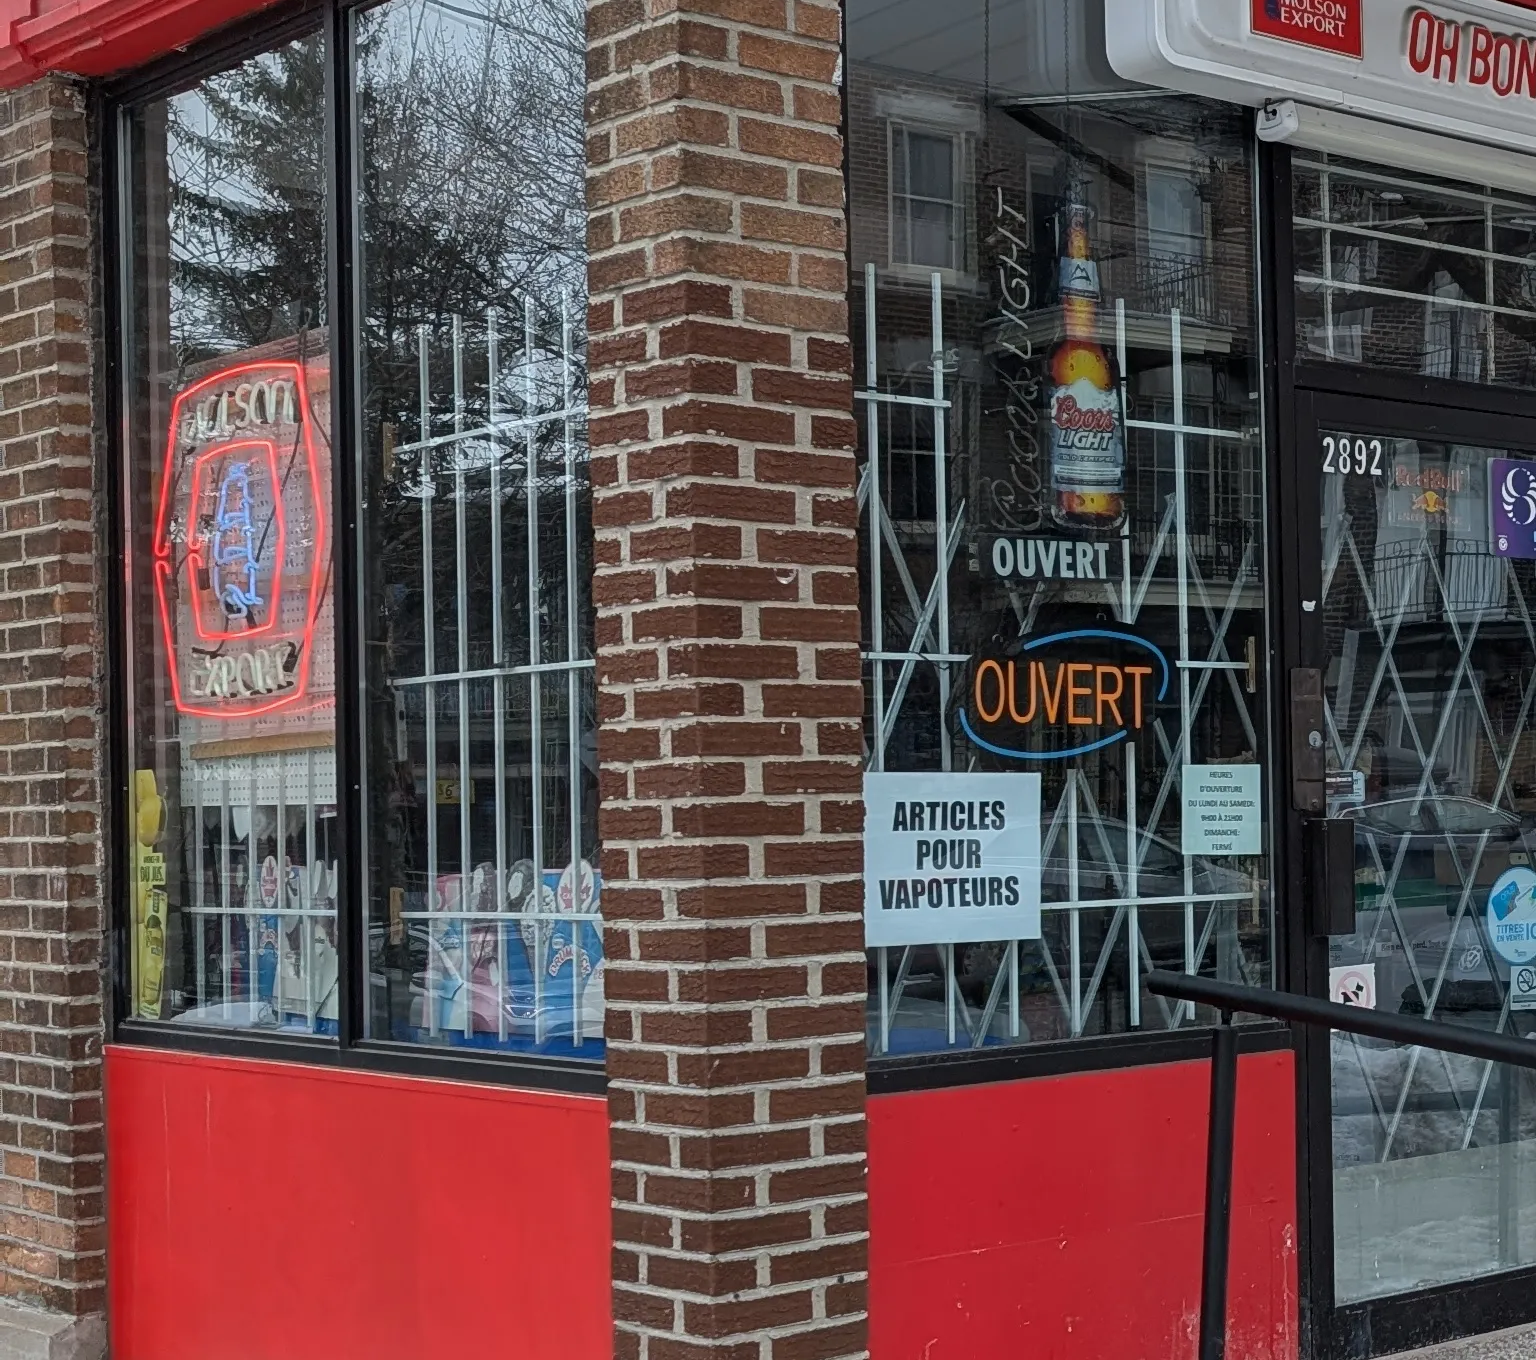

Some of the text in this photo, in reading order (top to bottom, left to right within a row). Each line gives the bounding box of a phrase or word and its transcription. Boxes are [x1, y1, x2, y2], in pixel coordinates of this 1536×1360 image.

[1280, 8, 1346, 38] EXPORT
[1408, 10, 1461, 84] OH
[1055, 394, 1117, 432] Coors
[1057, 429, 1114, 451] LIGHT
[1322, 436, 1383, 476] 2892
[992, 537, 1110, 579] OUVERT
[975, 659, 1153, 729] OUVERT
[892, 800, 1006, 832] ARTICLES
[1188, 799, 1197, 807] DU
[916, 838, 982, 870] POUR
[879, 875, 1020, 910] VAPOTEURS
[1496, 922, 1524, 934] TITRES
